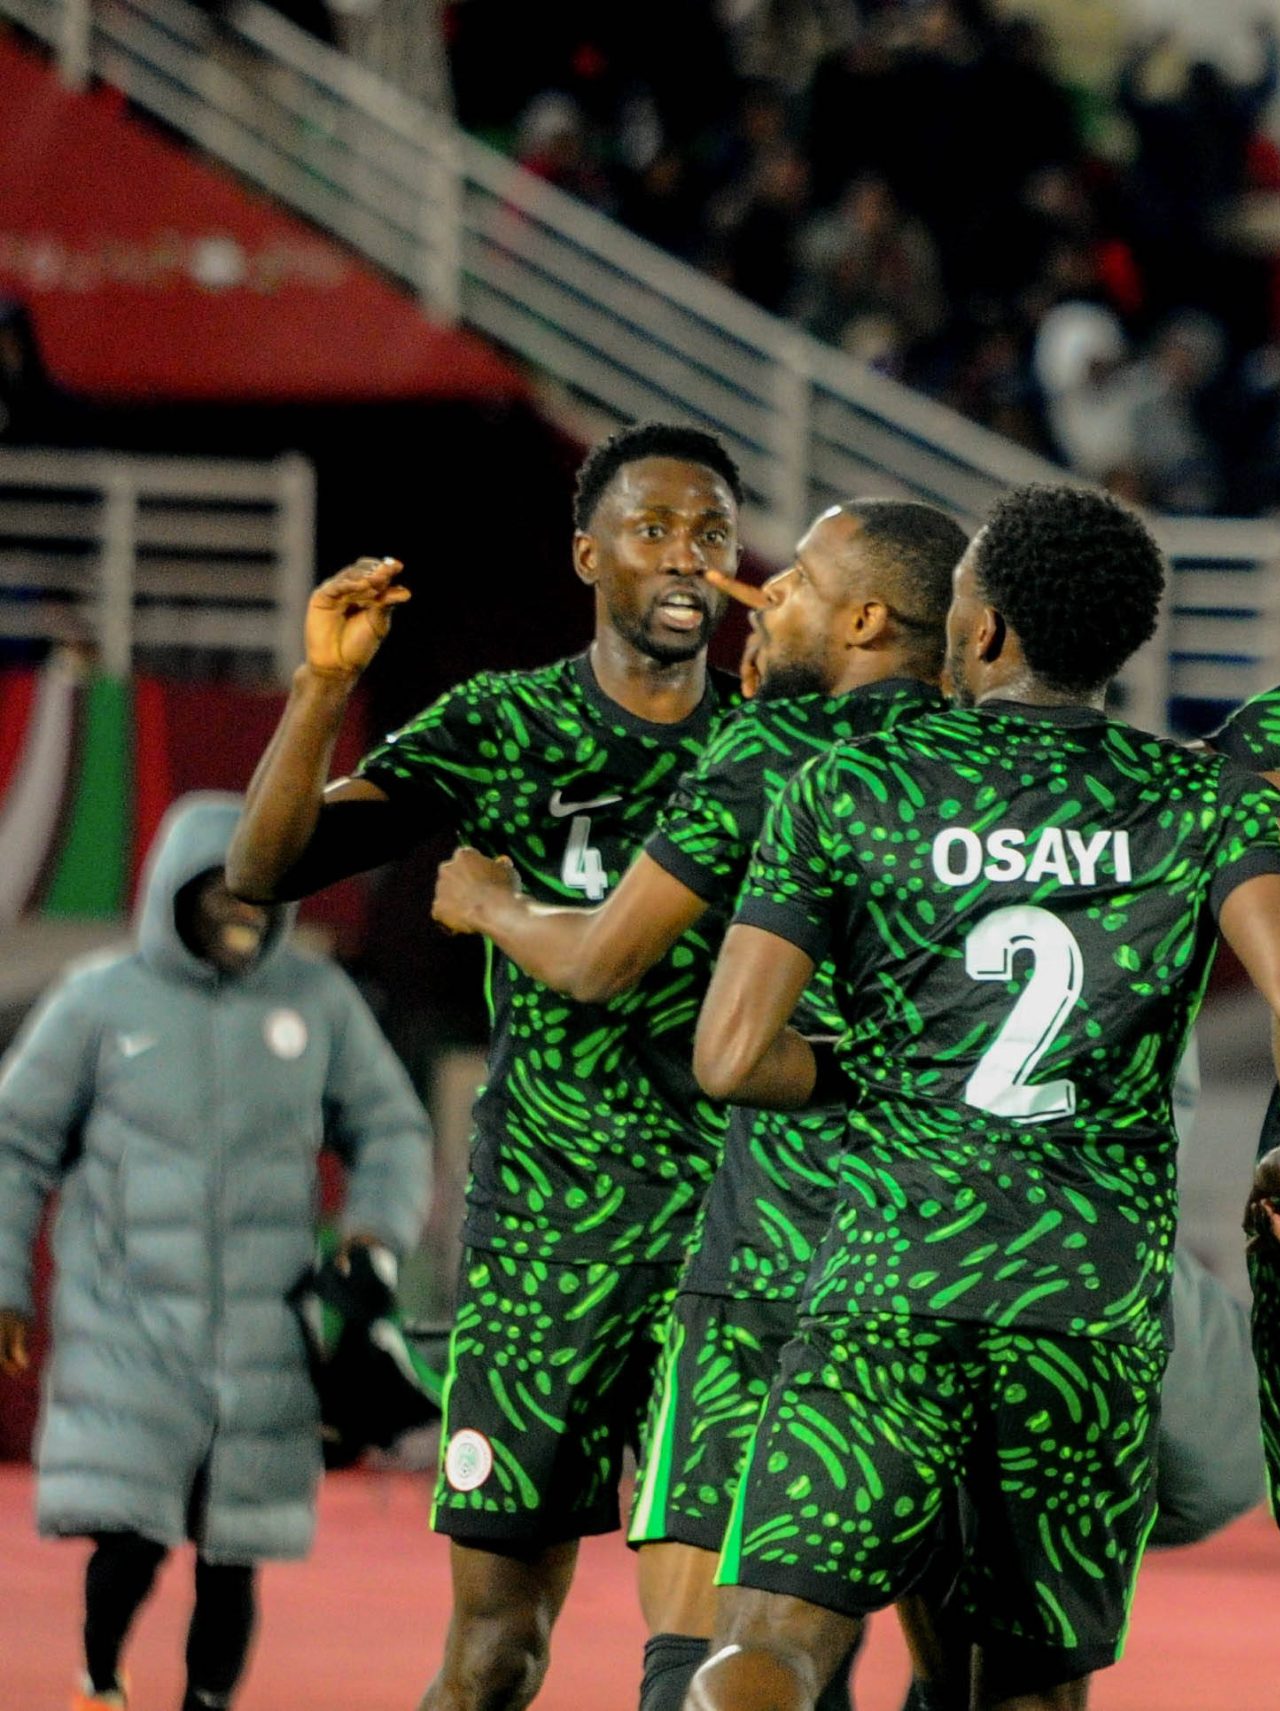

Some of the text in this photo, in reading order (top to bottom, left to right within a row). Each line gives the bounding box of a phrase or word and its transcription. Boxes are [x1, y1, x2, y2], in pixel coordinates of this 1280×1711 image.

[562, 815, 608, 900] 4
[932, 826, 1132, 887] OSAYI
[965, 904, 1084, 1124] 2
